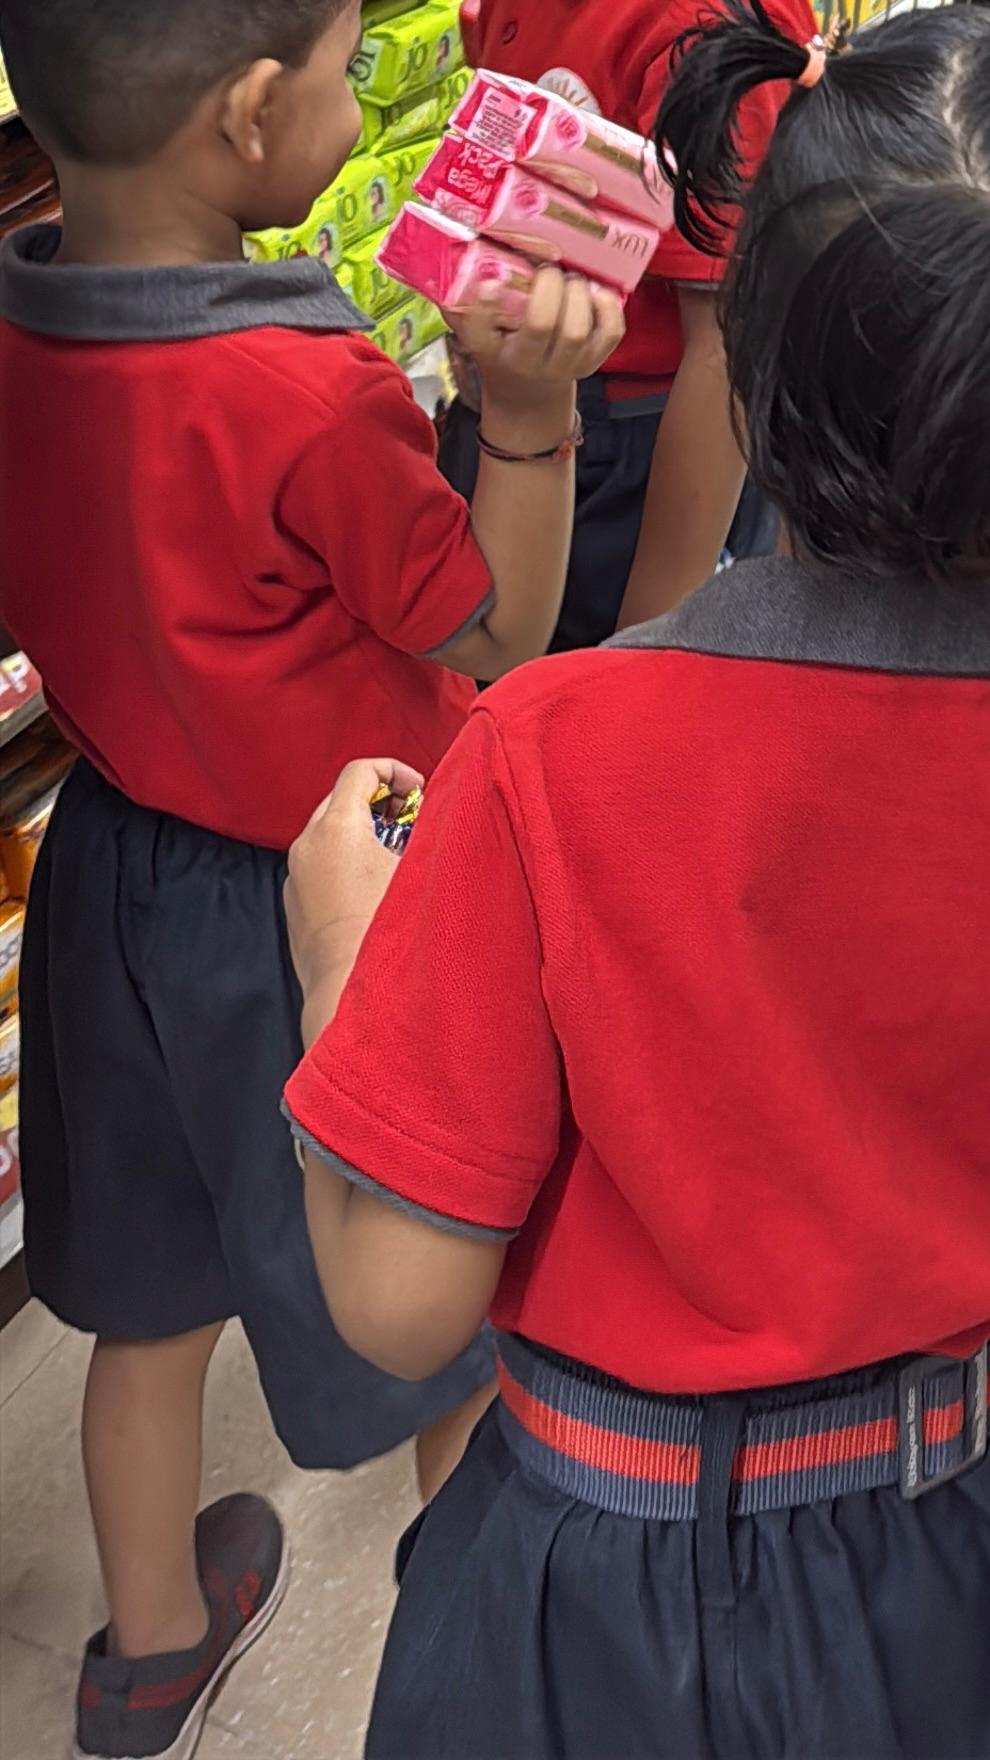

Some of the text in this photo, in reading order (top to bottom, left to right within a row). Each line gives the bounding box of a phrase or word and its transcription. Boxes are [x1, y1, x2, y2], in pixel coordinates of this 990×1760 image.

[456, 141, 504, 178] Pack
[447, 167, 493, 205] Mega
[607, 230, 650, 258] LUX
